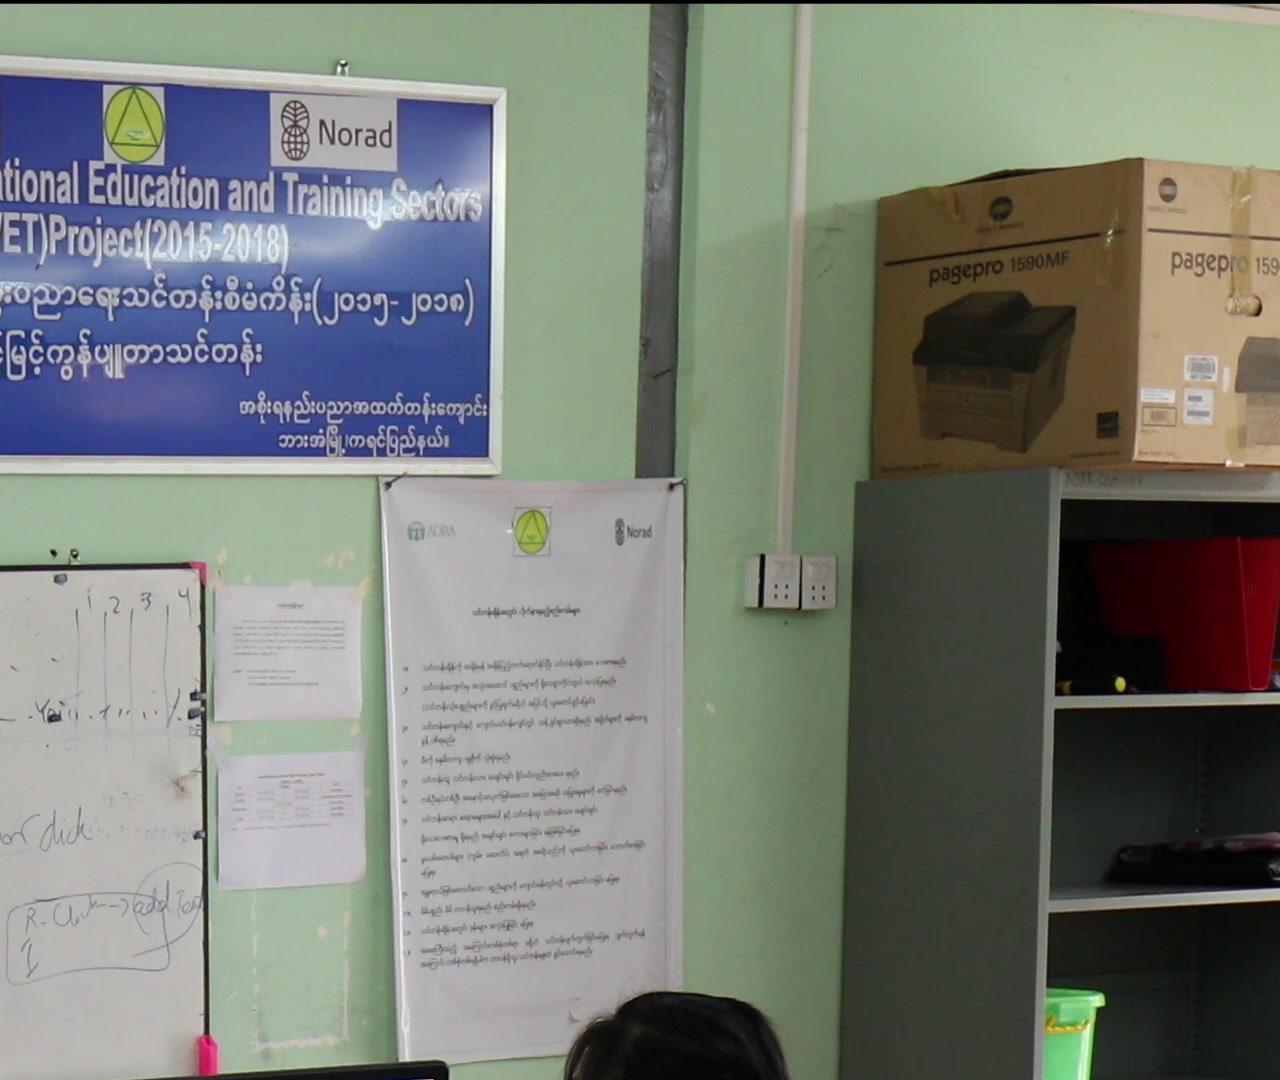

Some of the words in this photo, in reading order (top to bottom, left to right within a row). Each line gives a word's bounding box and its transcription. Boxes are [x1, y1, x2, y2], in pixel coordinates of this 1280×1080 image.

[319, 118, 392, 149] Norad
[88, 160, 220, 211] Education
[228, 171, 275, 215] and
[282, 172, 383, 231] Training
[390, 177, 483, 223] Sectors
[928, 259, 1004, 288] pagepro
[1171, 250, 1249, 279] pagepro
[626, 525, 653, 540] Norad
[108, 596, 121, 615] 2
[140, 591, 153, 612] 3
